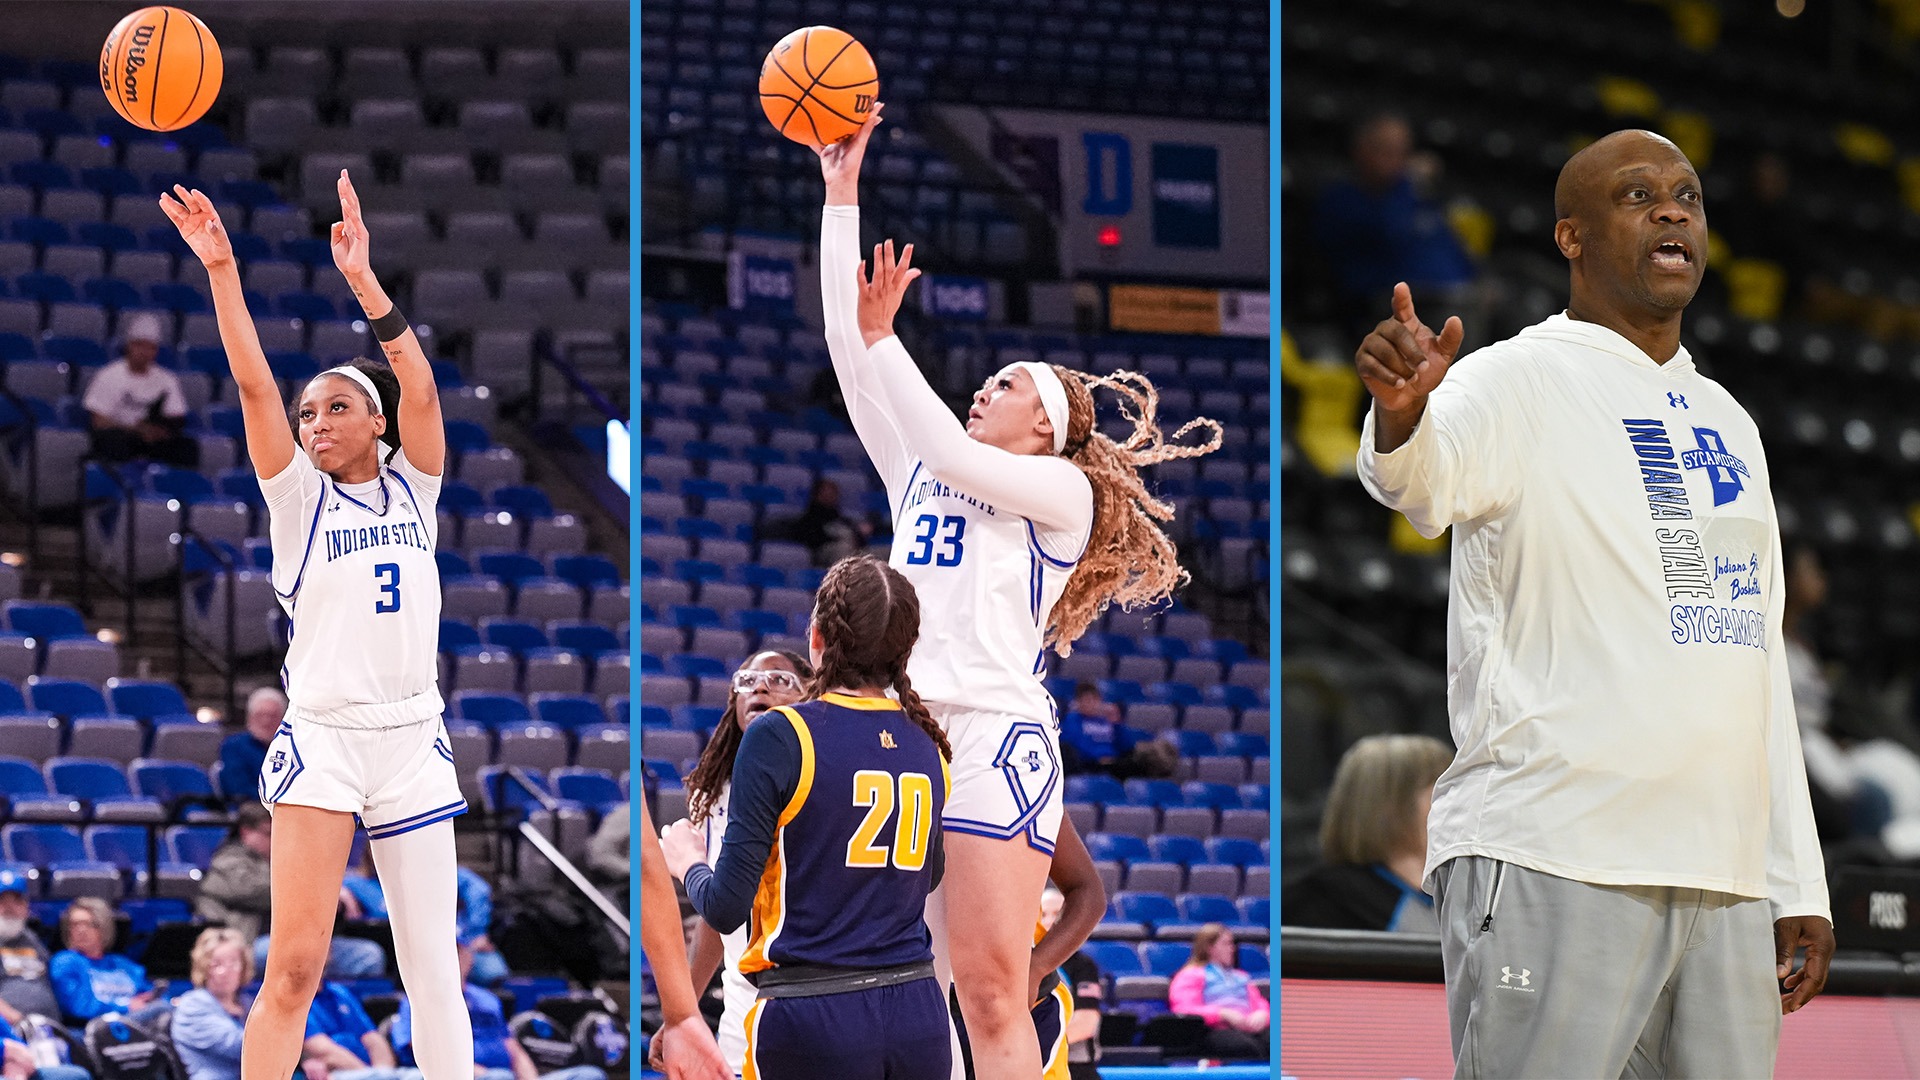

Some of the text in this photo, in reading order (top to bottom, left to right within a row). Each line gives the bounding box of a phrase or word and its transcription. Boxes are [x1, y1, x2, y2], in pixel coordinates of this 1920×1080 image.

[125, 25, 155, 103] Wilson
[1082, 131, 1132, 216] D
[748, 268, 793, 298] 105
[1622, 418, 1714, 598] INDIANA STATE
[325, 522, 427, 563] INDIANA STT
[906, 514, 966, 567] 33
[374, 562, 400, 614] 3
[1714, 554, 1747, 581] Indiana
[1670, 604, 1767, 652] SYCAMOR
[845, 769, 933, 871] 20
